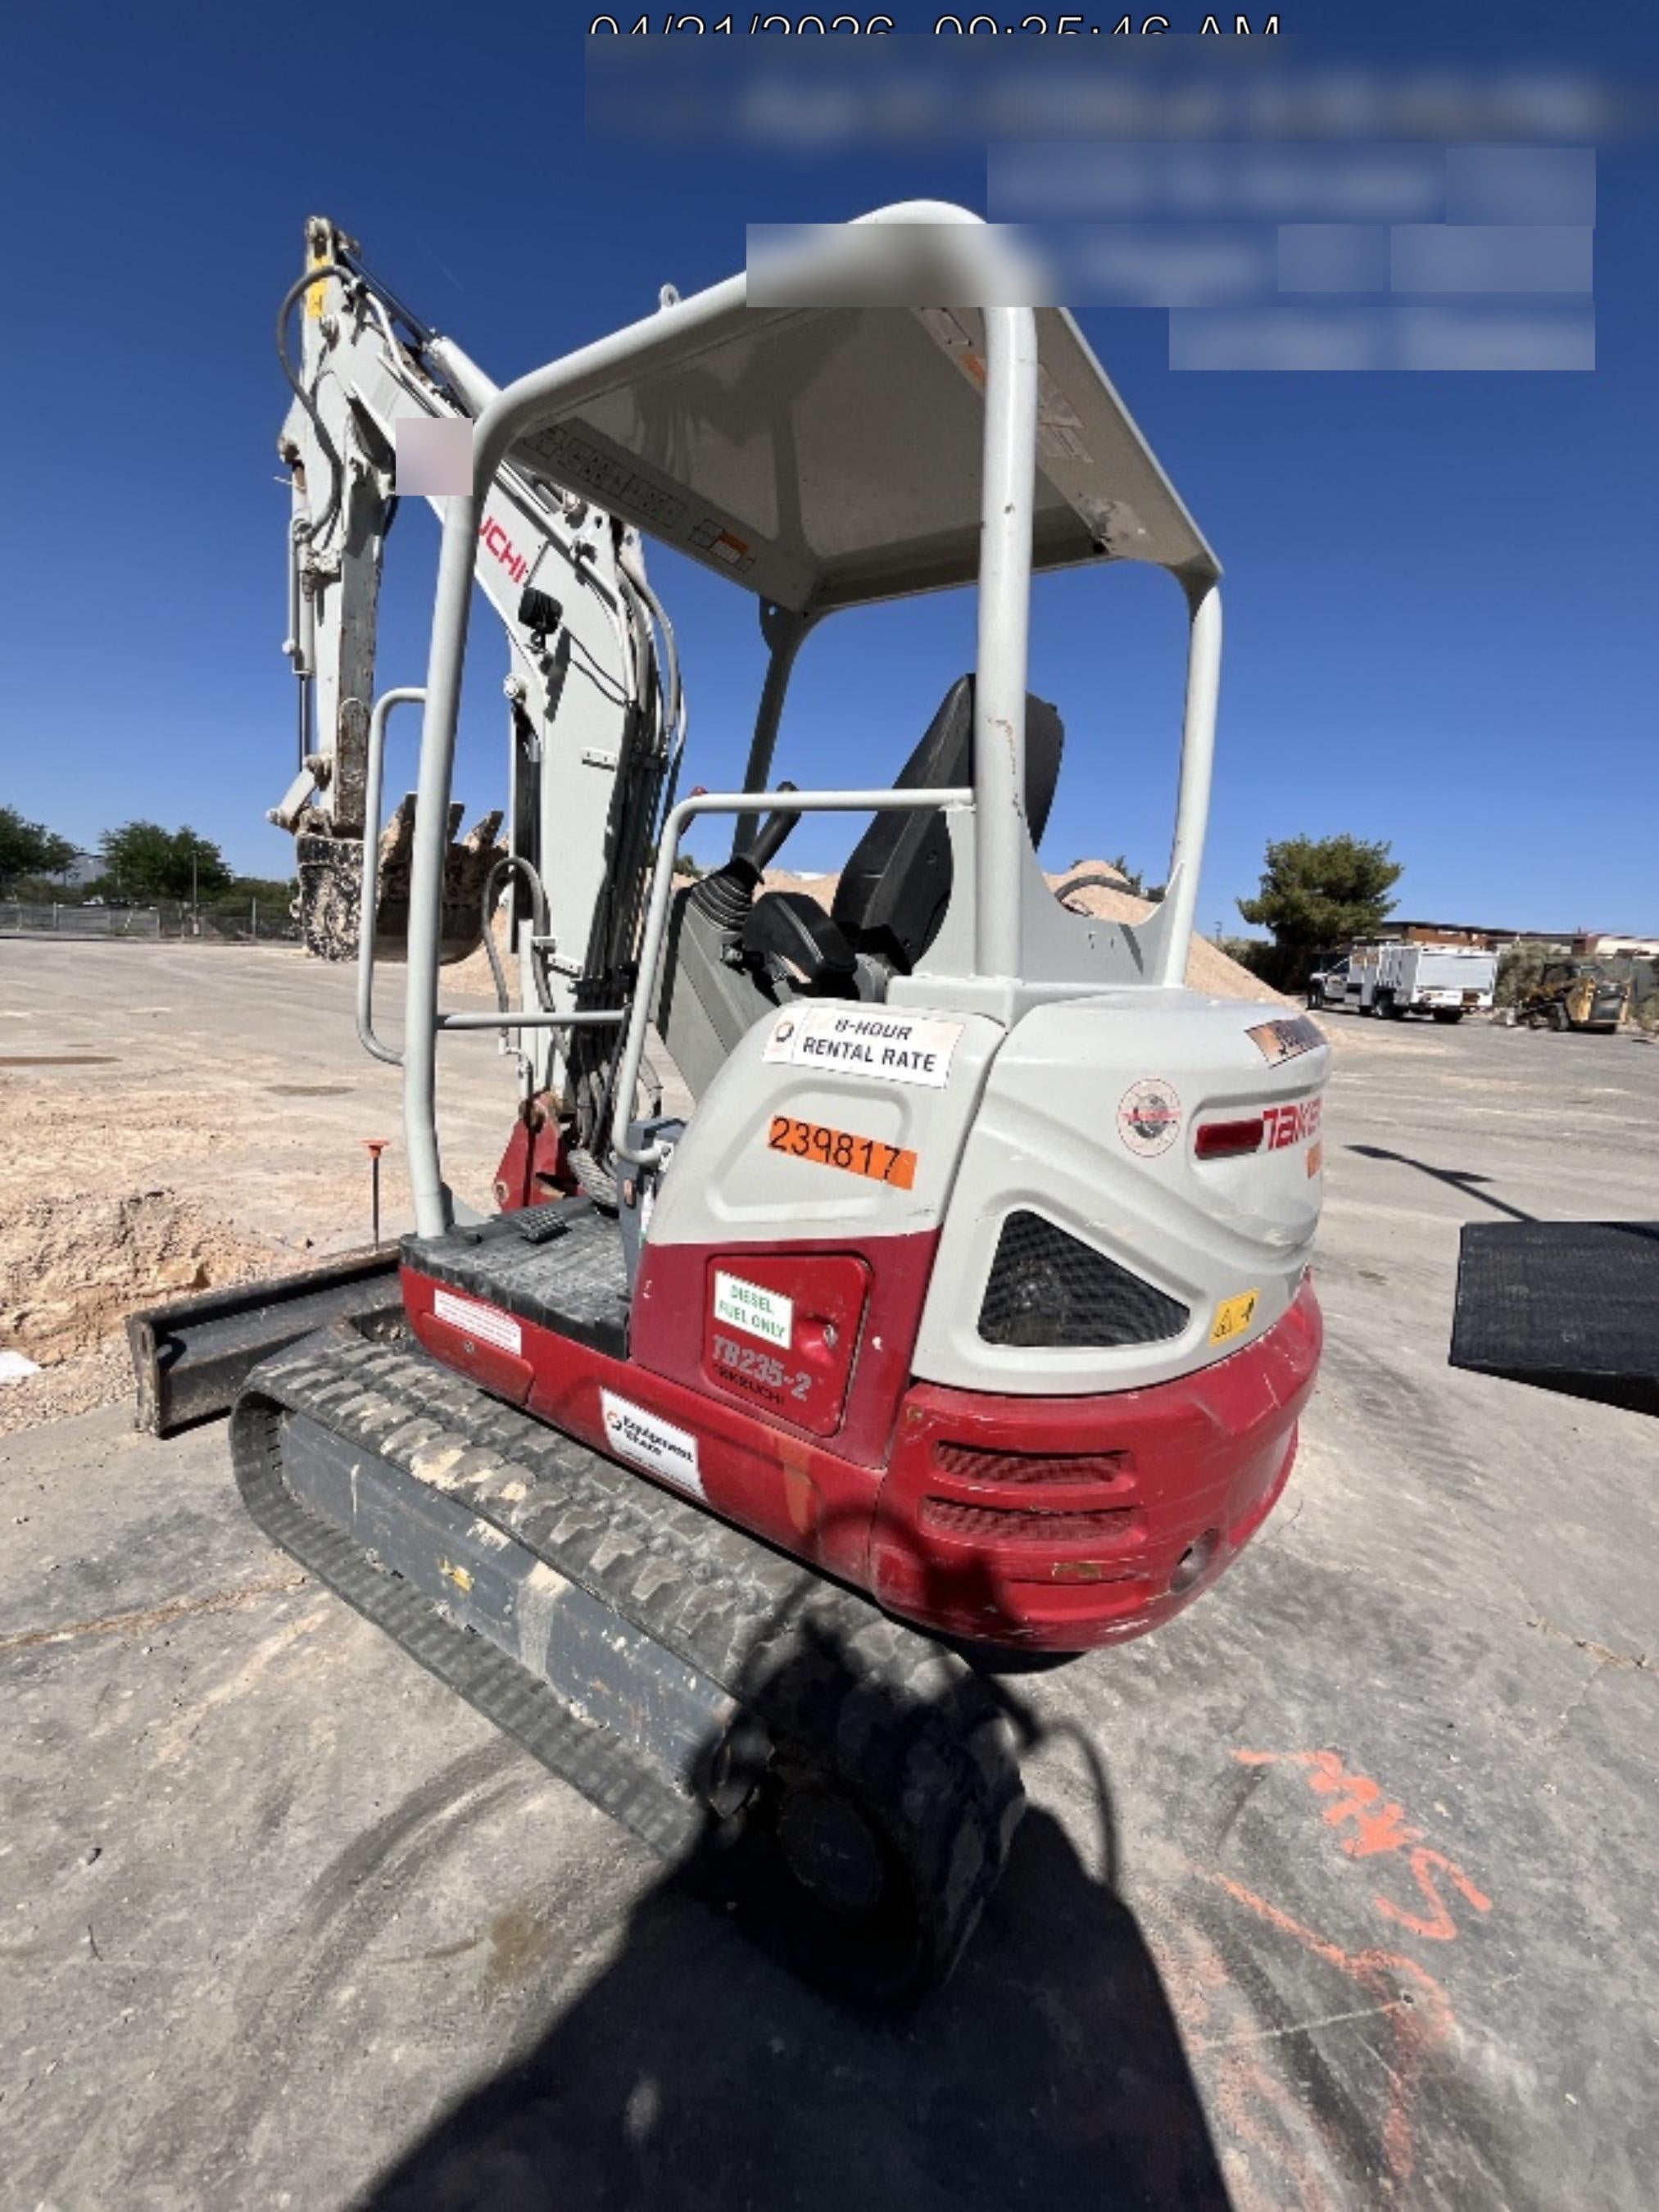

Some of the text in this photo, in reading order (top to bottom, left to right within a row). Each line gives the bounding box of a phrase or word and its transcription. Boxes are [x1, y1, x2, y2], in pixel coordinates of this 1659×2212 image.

[803, 1036, 936, 1072] RENTAL RATE
[768, 1116, 900, 1181] 239817
[730, 1284, 773, 1313] DIESEL
[718, 1299, 786, 1339] FUEL ONLY
[713, 1334, 812, 1402] TB235-2
